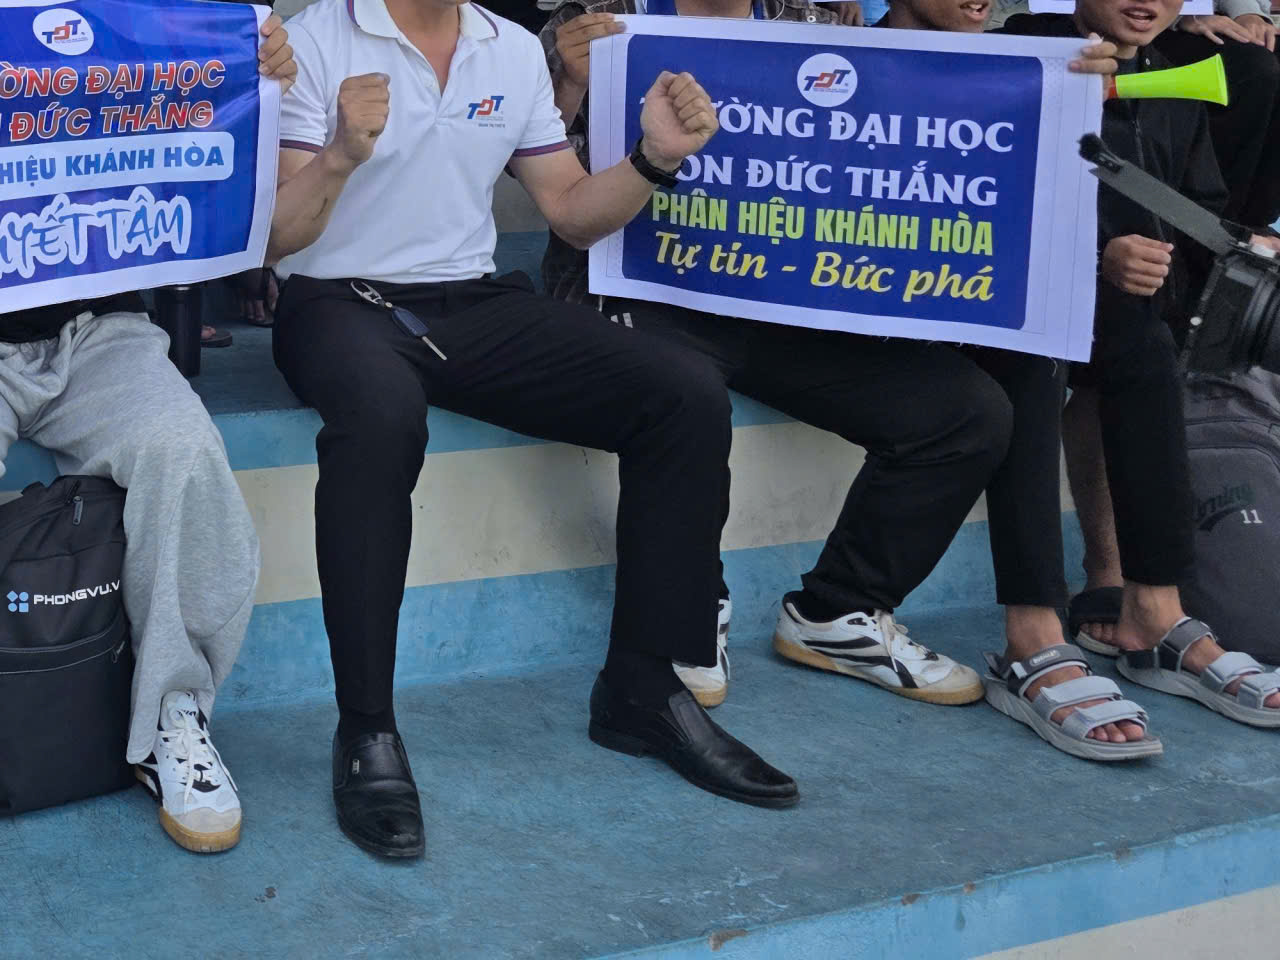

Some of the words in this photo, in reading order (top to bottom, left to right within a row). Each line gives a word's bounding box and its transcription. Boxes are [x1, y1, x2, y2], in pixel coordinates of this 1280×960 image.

[85, 62, 144, 102] ĐẠI
[152, 59, 226, 100] HỌC
[9, 104, 90, 143] ĐỨC
[100, 95, 214, 134] THẮNG
[828, 111, 901, 152] ĐẠI
[916, 115, 1014, 157] HỌC
[65, 146, 155, 178] KHÁNH
[163, 140, 225, 168] HÒA
[746, 155, 832, 194] ĐỨC
[844, 159, 999, 207] THẮNG
[102, 196, 185, 254] TÂM
[651, 188, 727, 233] PHÂN
[738, 197, 804, 247] HIỆU
[815, 203, 920, 251] KHÁNH
[930, 209, 994, 257] HÒA
[654, 230, 699, 276] Tự
[710, 237, 768, 280] tin
[781, 264, 797, 273] -
[810, 252, 894, 294] Bức
[903, 264, 995, 304] phá
[1239, 509, 1263, 524] 11
[33, 579, 120, 605] PHONGVU.V
